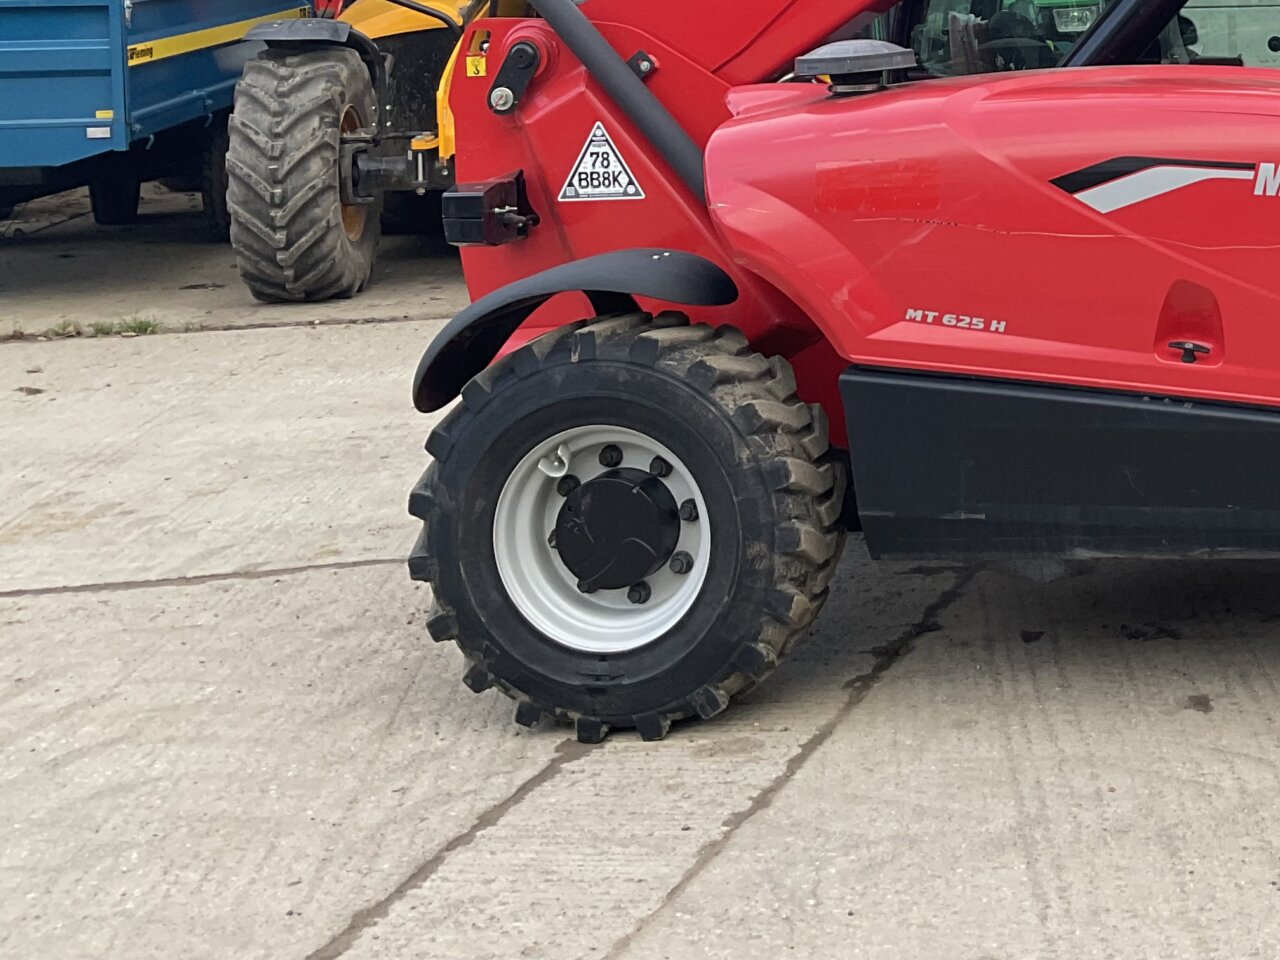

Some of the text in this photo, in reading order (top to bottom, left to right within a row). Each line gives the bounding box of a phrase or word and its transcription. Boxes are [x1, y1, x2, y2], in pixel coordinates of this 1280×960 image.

[589, 151, 611, 169] 78
[578, 170, 623, 189] BB8K
[905, 308, 1006, 333] MT 625 H
